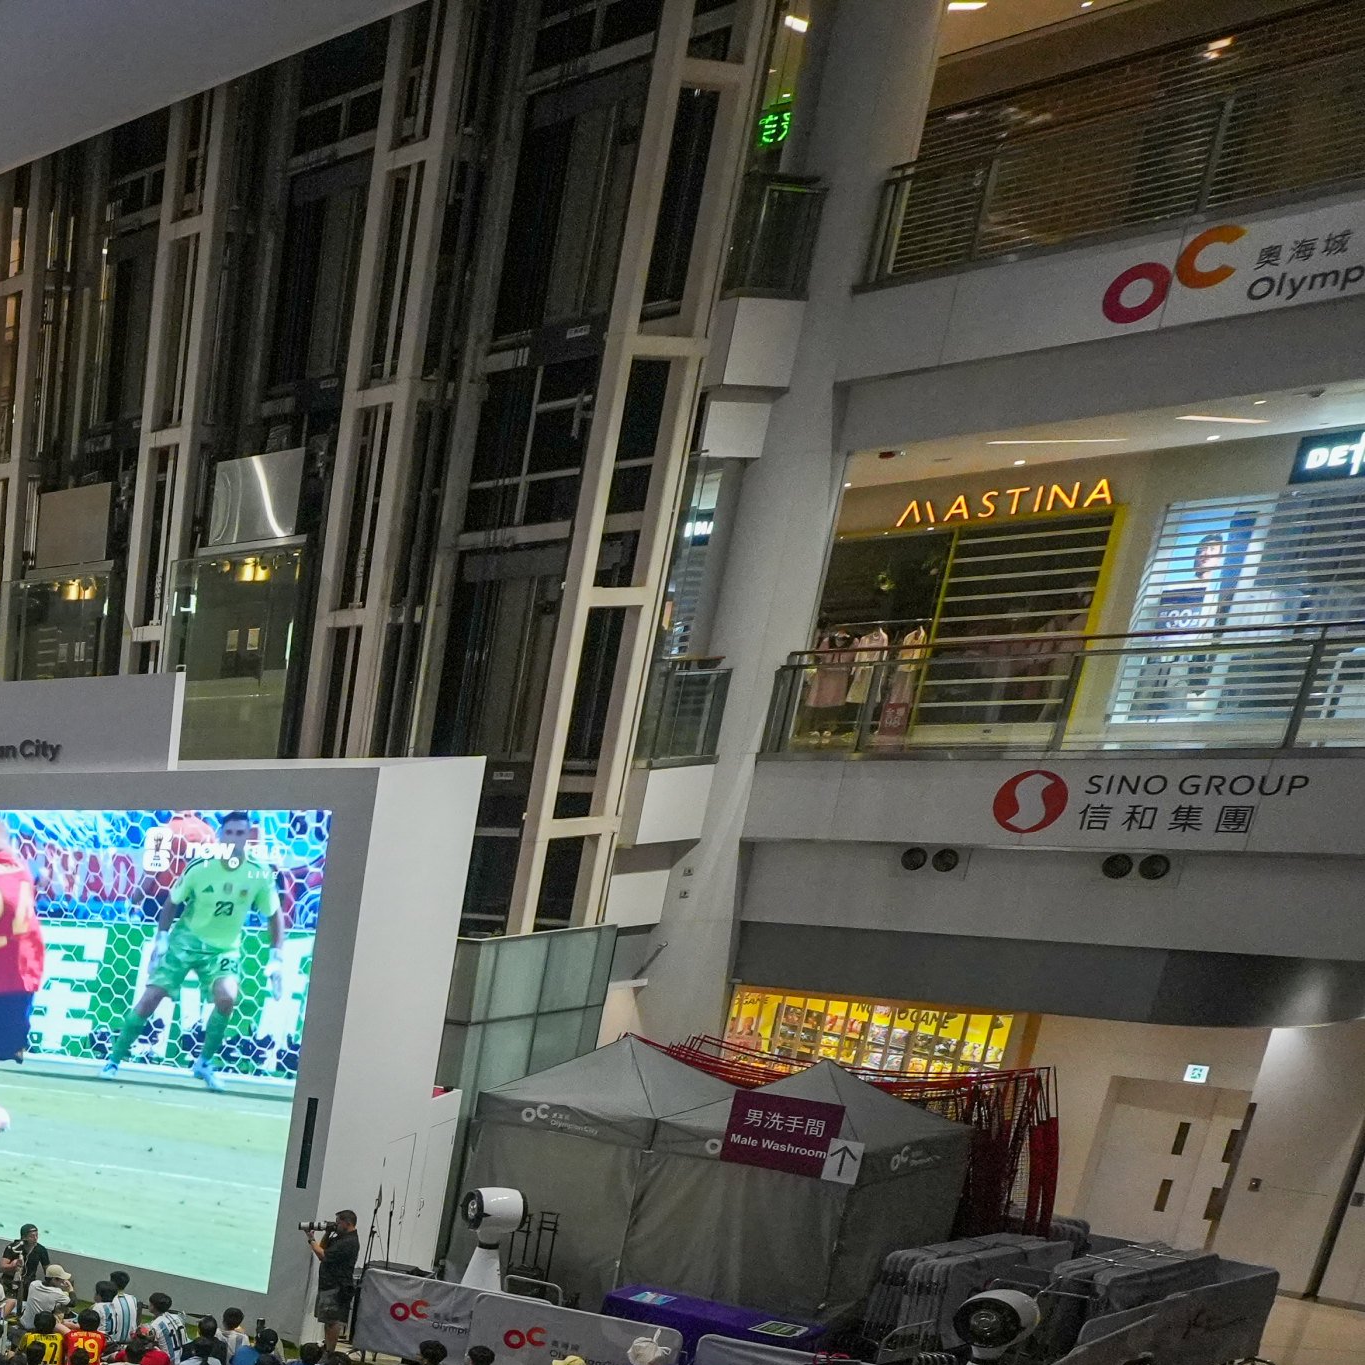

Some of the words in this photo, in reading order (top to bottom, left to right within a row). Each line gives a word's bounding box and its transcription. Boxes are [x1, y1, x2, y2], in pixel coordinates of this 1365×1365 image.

[1253, 229, 1351, 270] 奧海城
[1102, 224, 1247, 323] OC
[19, 739, 62, 760] City
[1084, 773, 1169, 797] SINO
[1179, 773, 1311, 797] GROUP
[1076, 803, 1254, 836] 信和集團
[215, 899, 236, 917] 23
[521, 1103, 550, 1123] OC
[744, 1108, 826, 1138] 男洗手間
[729, 1133, 759, 1150] Male
[761, 1138, 827, 1160] Washroom
[389, 1299, 430, 1322] OC
[503, 1326, 548, 1350] OC
